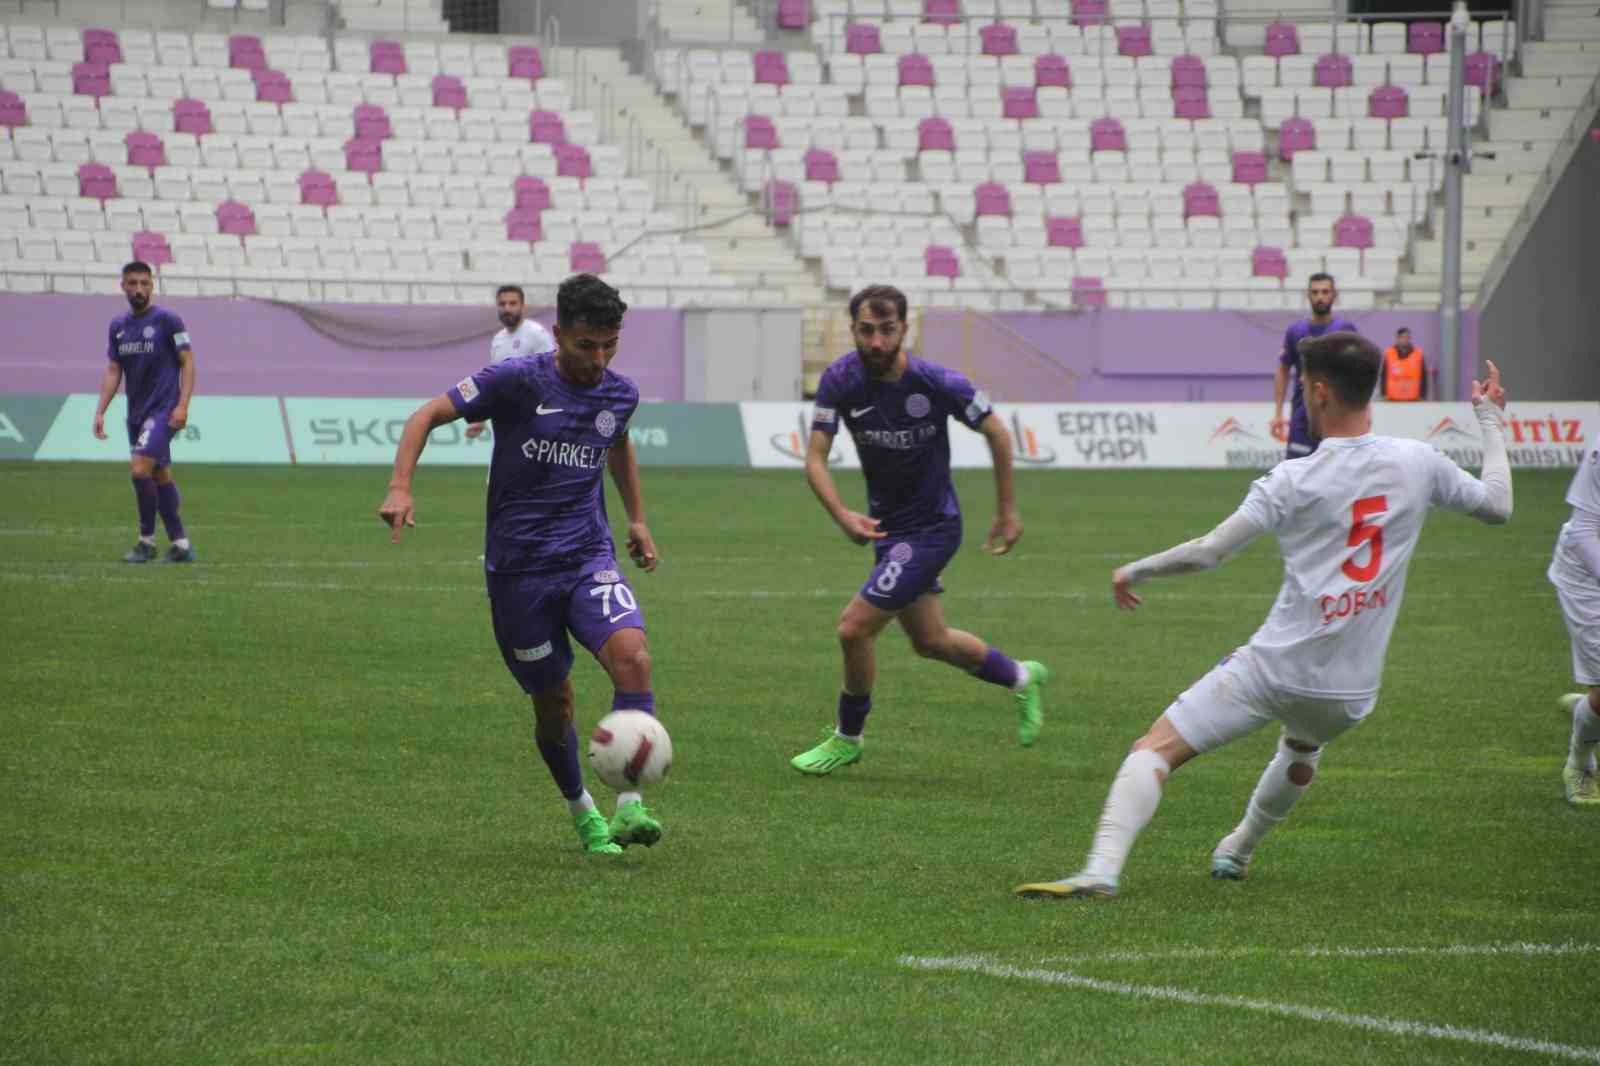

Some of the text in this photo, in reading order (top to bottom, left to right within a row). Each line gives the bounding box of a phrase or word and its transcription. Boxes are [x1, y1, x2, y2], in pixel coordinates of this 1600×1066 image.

[1057, 411, 1157, 435] ERTAN
[1503, 413, 1585, 443] İTİZ
[1076, 439, 1147, 461] YAPI
[1340, 494, 1388, 583] 5
[877, 561, 903, 592] 8
[590, 583, 637, 616] 70
